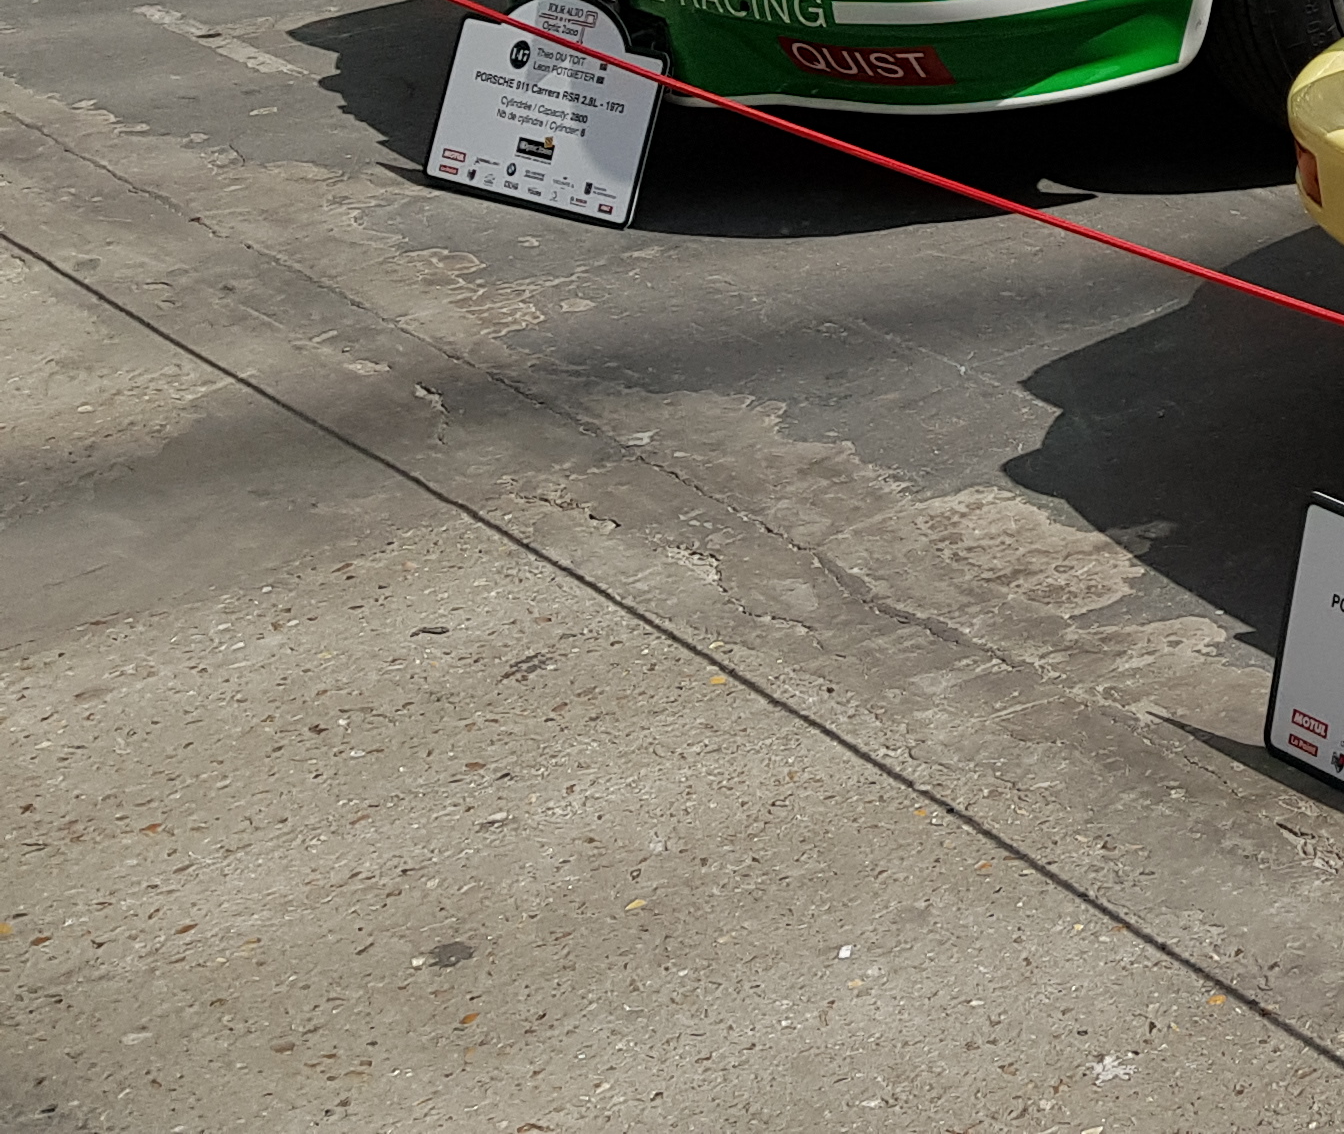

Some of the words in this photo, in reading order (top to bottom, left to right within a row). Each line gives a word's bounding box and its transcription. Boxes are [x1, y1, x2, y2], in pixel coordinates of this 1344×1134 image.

[790, 40, 928, 80] QUIST
[475, 70, 514, 89] PORSCHE
[531, 83, 560, 100] Carrera
[1293, 711, 1327, 737] MOTUL
